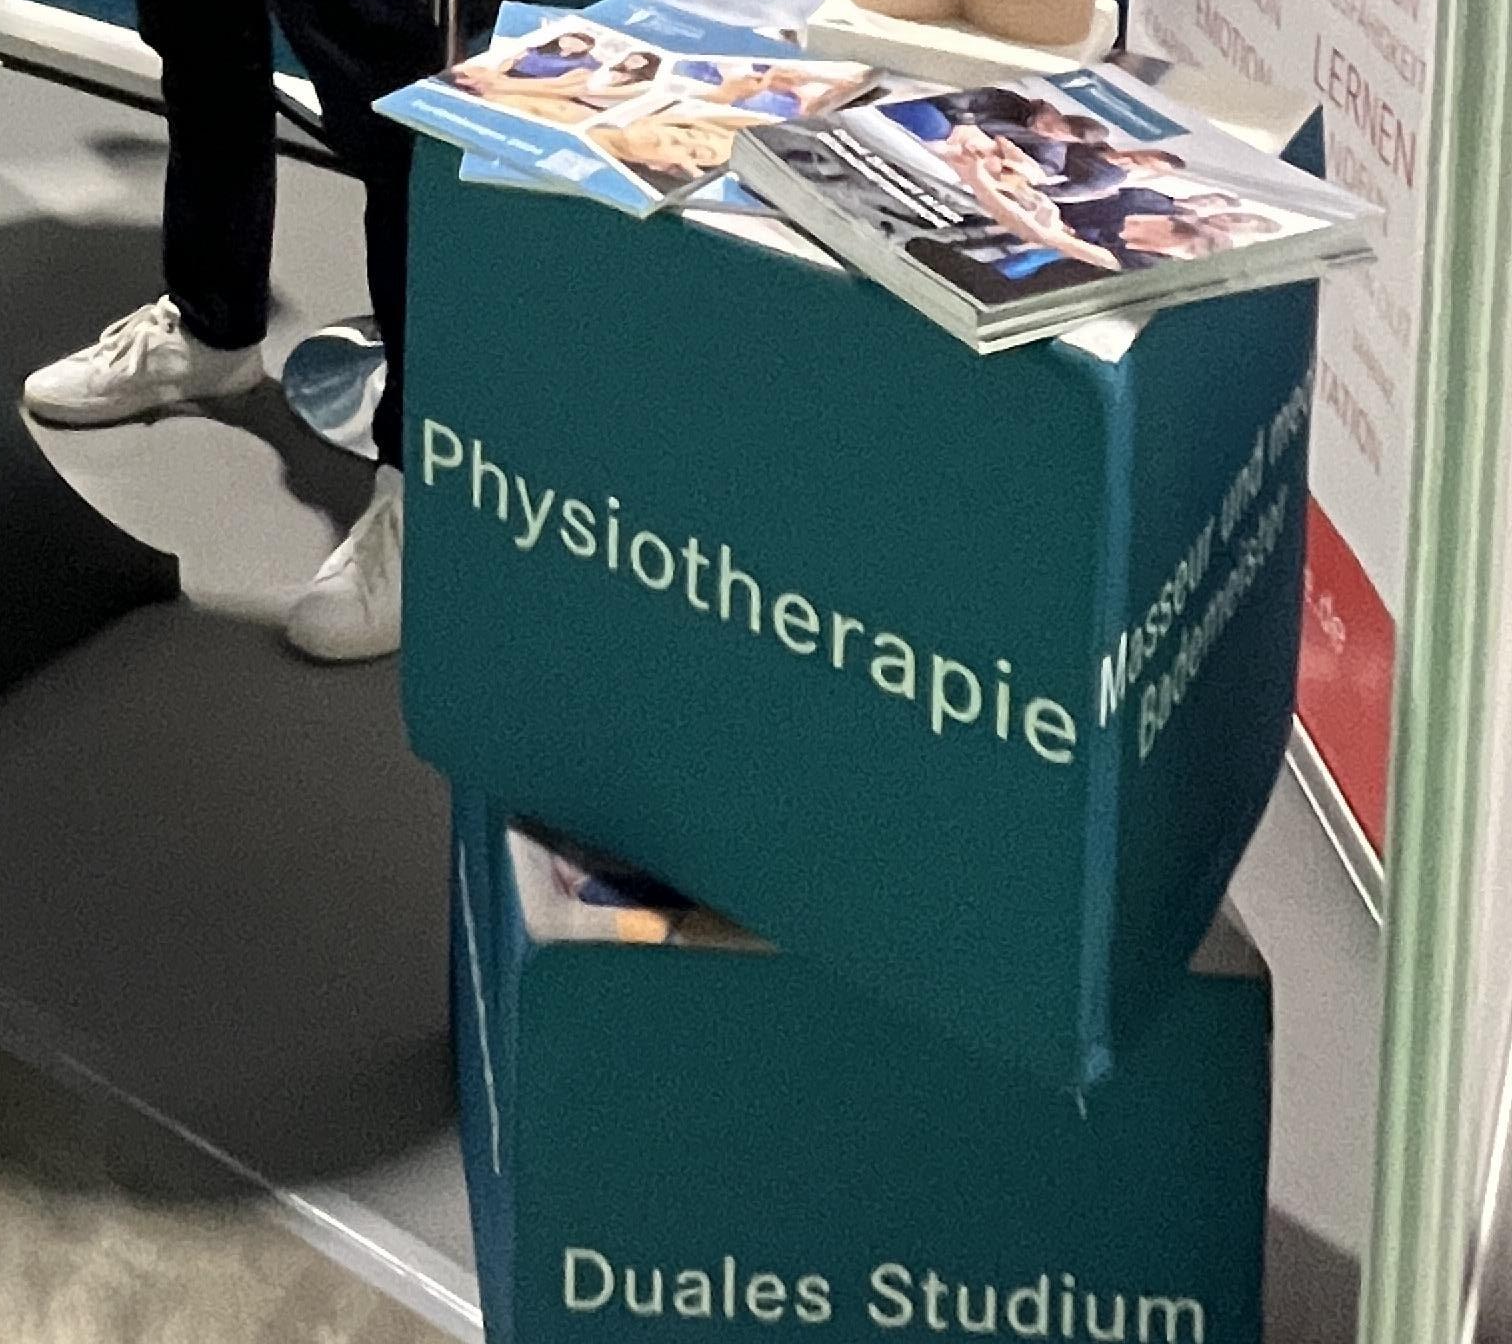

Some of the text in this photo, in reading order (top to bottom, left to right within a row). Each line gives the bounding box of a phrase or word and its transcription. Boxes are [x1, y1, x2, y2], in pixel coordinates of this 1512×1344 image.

[1312, 32, 1417, 188] LERNEN
[422, 418, 1078, 764] Physiotherapie
[1100, 513, 1216, 729] Masseur
[563, 1246, 1205, 1344] Duales Studium
